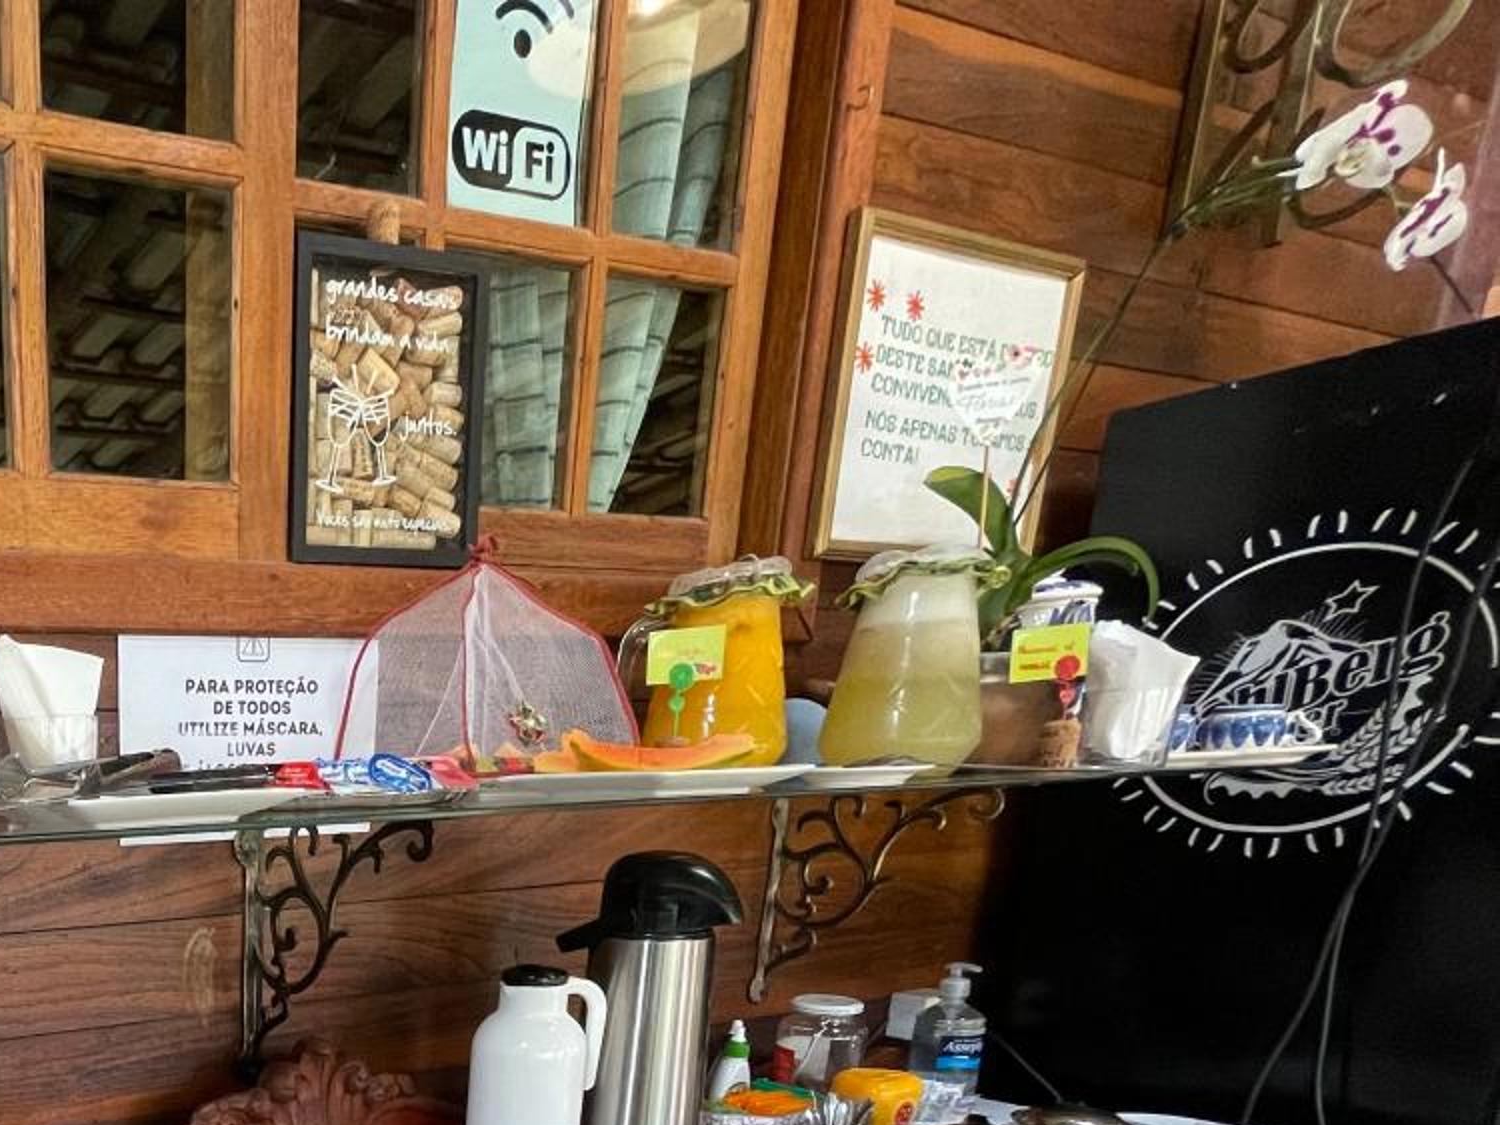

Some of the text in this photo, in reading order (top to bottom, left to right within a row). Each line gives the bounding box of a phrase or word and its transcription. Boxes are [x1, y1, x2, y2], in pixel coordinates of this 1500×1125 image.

[461, 126, 555, 184] WiFi
[324, 276, 399, 305] grandes
[881, 314, 923, 344] TUDO
[925, 327, 956, 352] QUE
[876, 343, 925, 374] DESTE
[899, 416, 957, 444] APENAS
[185, 676, 319, 698] PARA PROTEÇÃO
[213, 700, 292, 715] DE TODOS
[179, 717, 323, 737] UTILIZE MÁSCARA,
[227, 742, 276, 757] LUVAS
